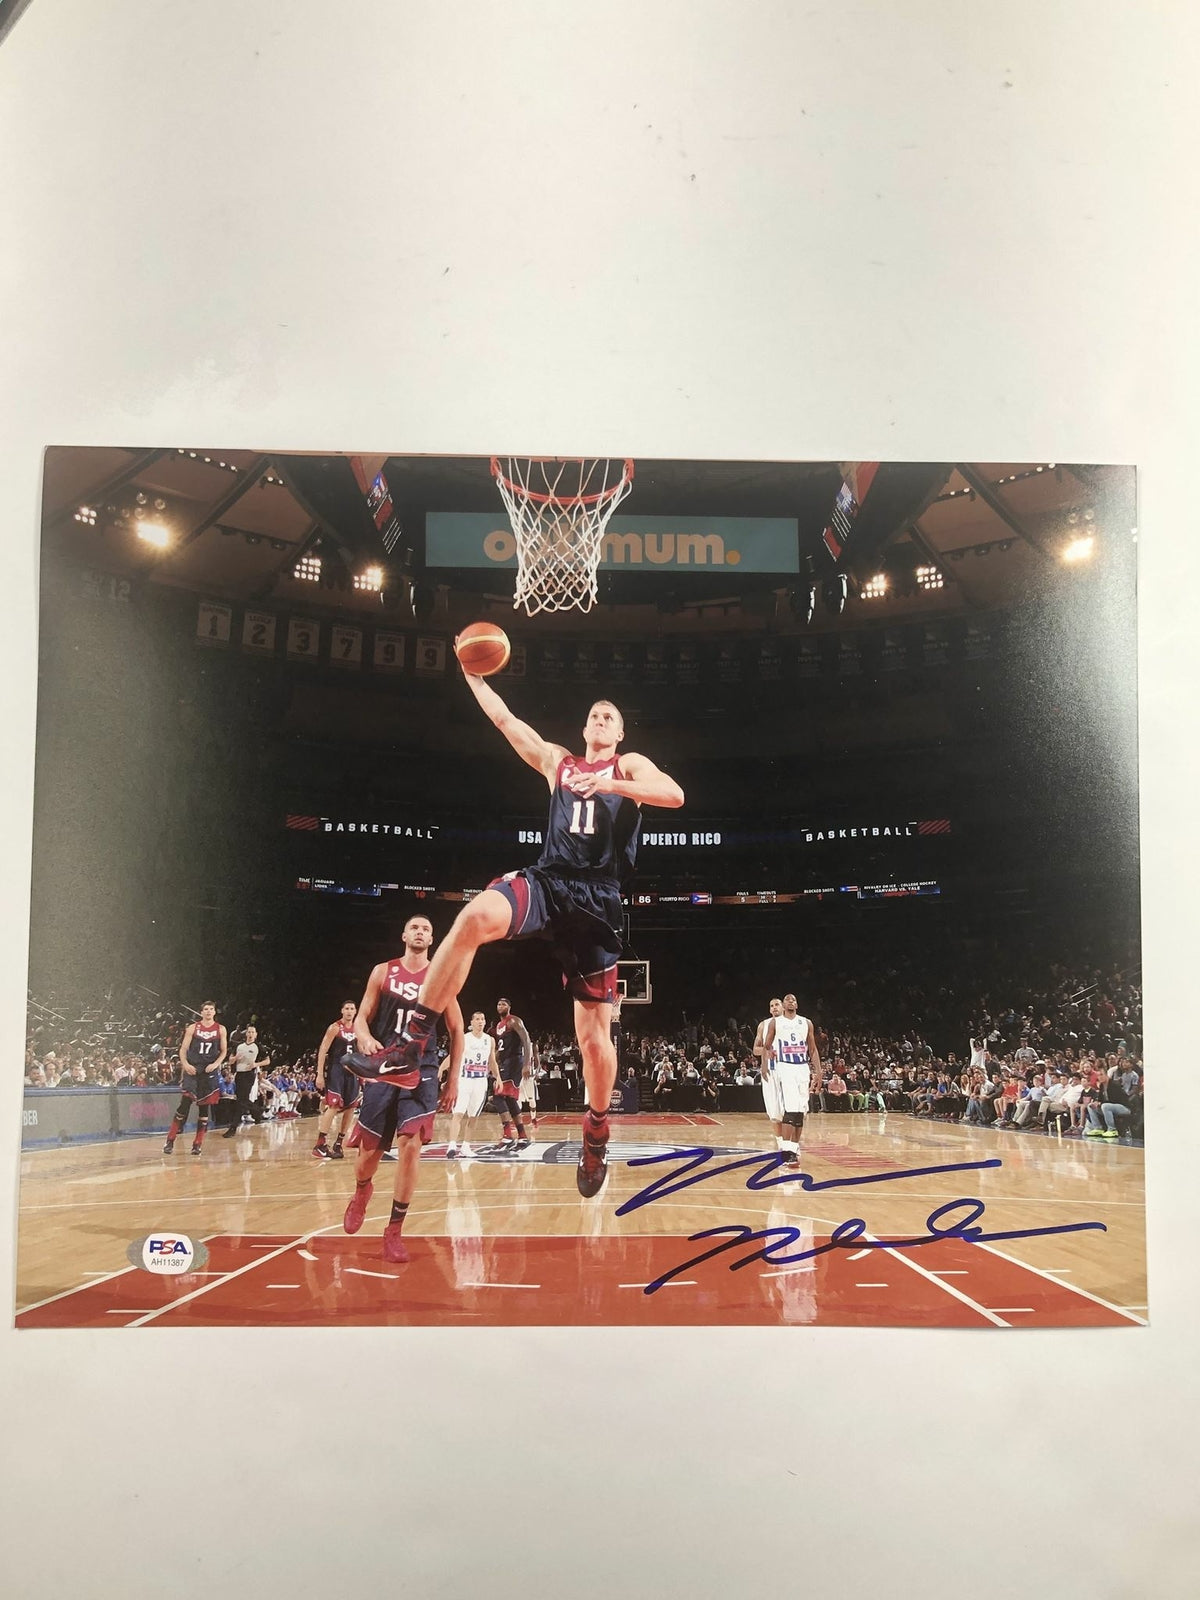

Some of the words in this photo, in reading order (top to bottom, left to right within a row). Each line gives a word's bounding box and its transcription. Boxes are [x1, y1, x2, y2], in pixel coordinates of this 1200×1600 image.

[209, 615, 218, 636] 1
[252, 623, 266, 645] 2
[296, 630, 310, 652] 3
[340, 637, 354, 657] 7
[383, 643, 396, 663] 9
[424, 648, 438, 667] 9
[569, 801, 595, 834] 11
[325, 823, 433, 839] BASKETBALL
[518, 830, 543, 844] USA
[805, 827, 912, 842] BASKETBALL
[642, 833, 687, 846] PUERTO
[692, 832, 721, 846] RICO
[638, 895, 651, 904] 86
[389, 978, 424, 1001] US
[498, 1038, 505, 1051] 2
[790, 1032, 796, 1042] 6
[199, 1042, 212, 1054] 17
[346, 1045, 353, 1054] 5
[476, 1052, 482, 1062] 9
[149, 1239, 189, 1255] PSA
[151, 1258, 184, 1267] AH11387
